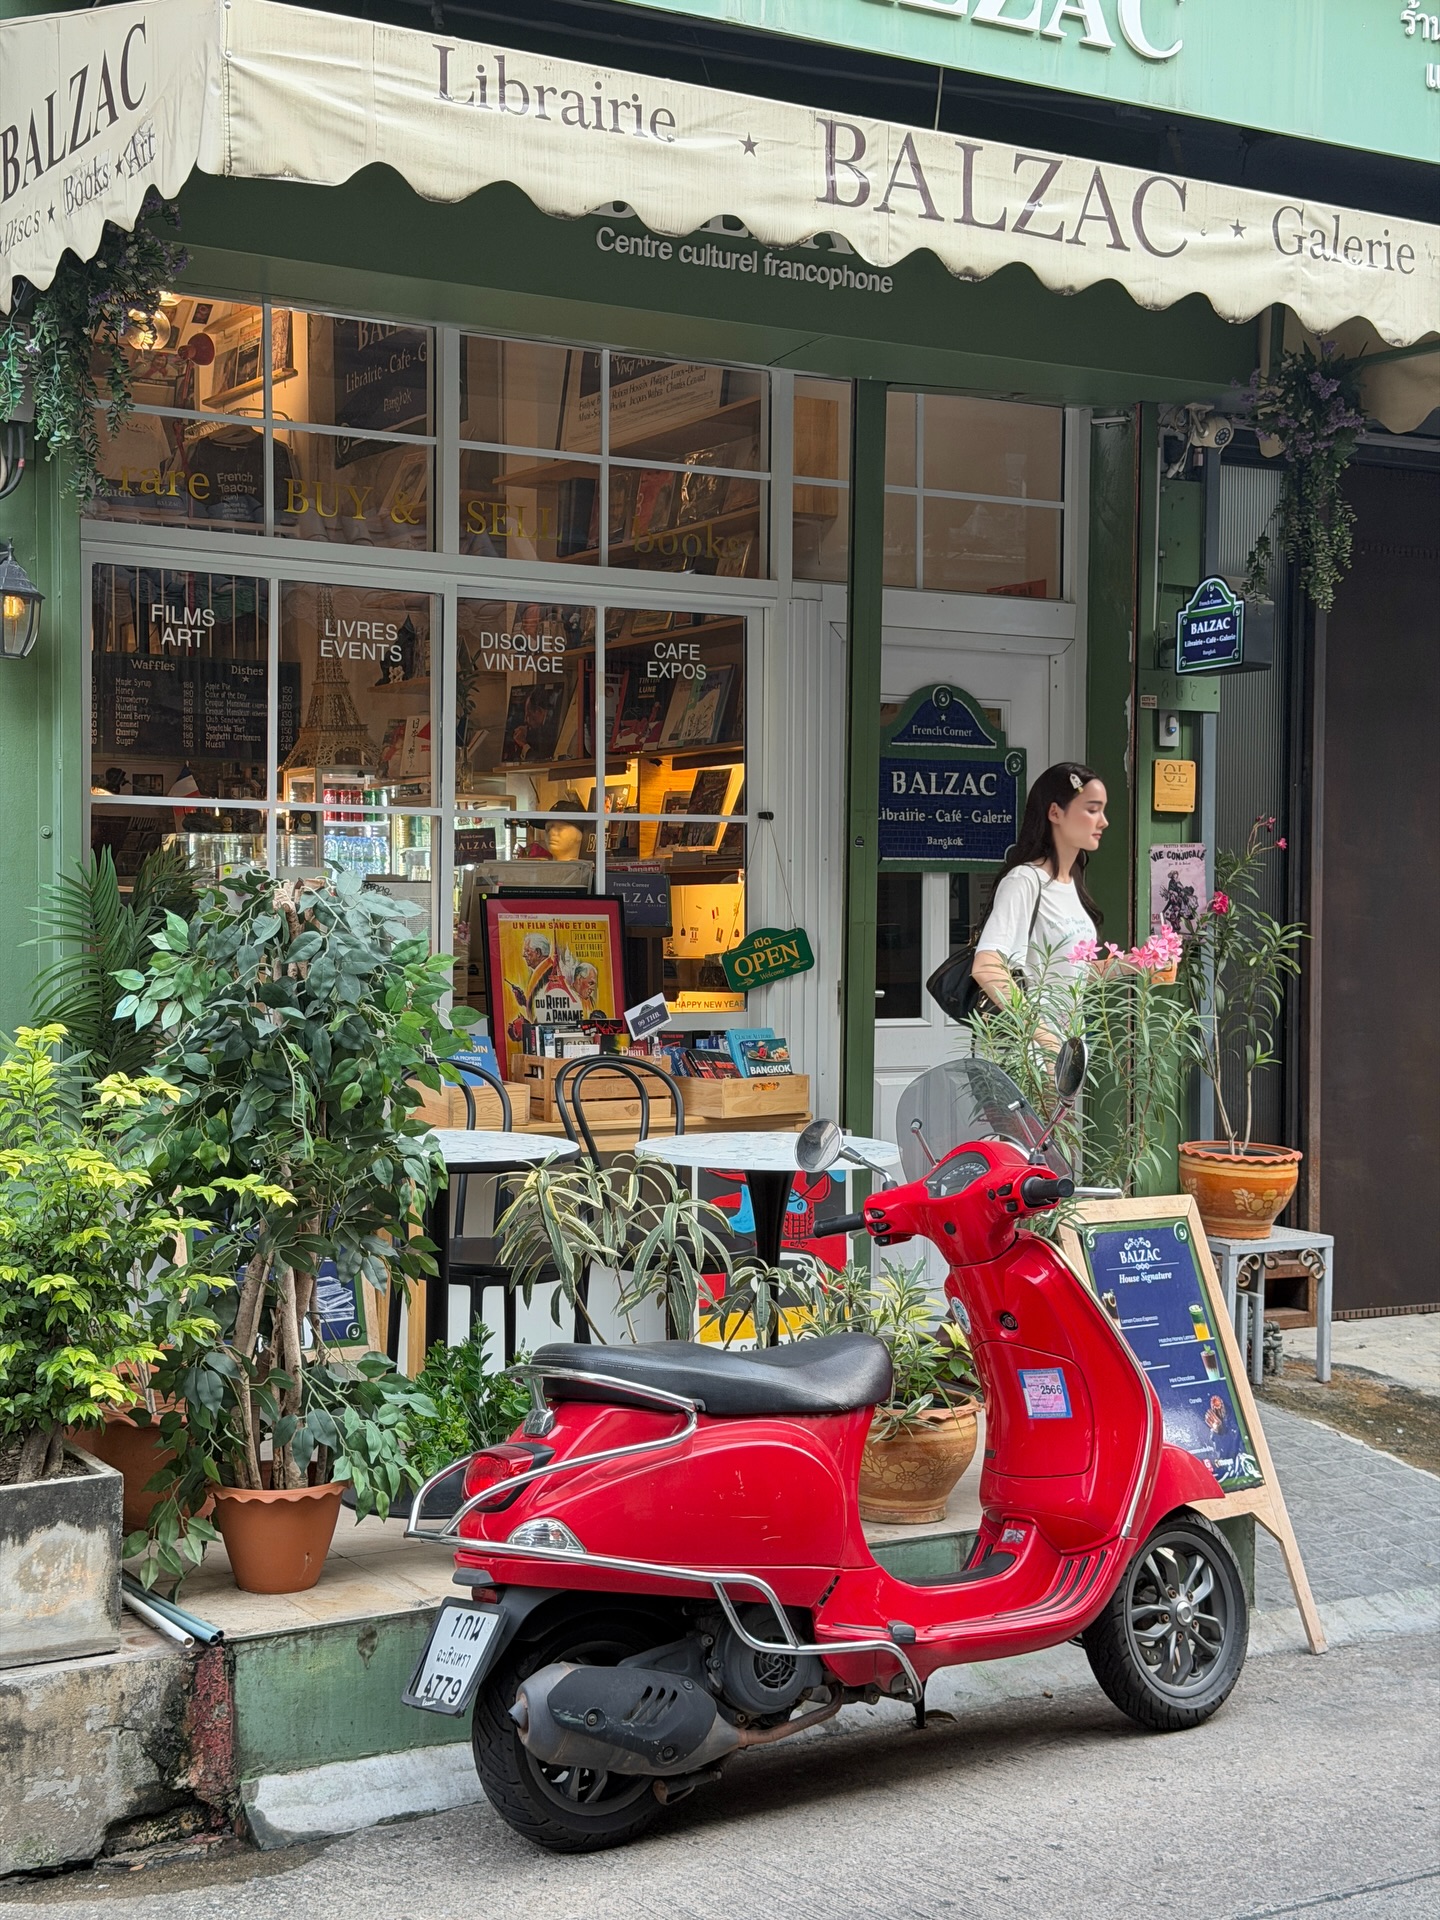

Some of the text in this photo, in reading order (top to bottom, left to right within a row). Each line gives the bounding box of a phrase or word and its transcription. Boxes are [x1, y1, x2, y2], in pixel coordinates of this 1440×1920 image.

[0, 15, 147, 204] BALZAC
[432, 43, 677, 144] Librairie
[815, 117, 1188, 259] BALZAC
[1271, 204, 1417, 275] Galerie
[63, 156, 110, 214] Books
[123, 127, 155, 179] Art
[595, 225, 673, 261] Centre
[678, 243, 758, 273] culturel
[763, 252, 894, 293] francophone
[346, 364, 383, 393] Librairie
[389, 348, 411, 374] Café
[216, 471, 253, 484] French
[217, 482, 258, 495] Teacher
[120, 464, 211, 501] rare
[283, 477, 374, 521] BUY
[390, 489, 421, 525] &
[466, 499, 561, 540] SELL
[150, 603, 216, 628] FILMS
[325, 618, 399, 642] LIVRES
[1190, 617, 1231, 635] BALZAC
[161, 627, 206, 648] ART
[480, 631, 566, 654] DISQUES
[320, 640, 403, 662] EVENTS
[653, 641, 701, 661] CAFE
[131, 659, 176, 671] Waffles
[231, 664, 264, 677] Dishes
[482, 652, 564, 674] VINTAGE
[646, 661, 707, 680] EXPOS
[912, 724, 972, 737] French Corner
[891, 770, 997, 796] BALZAC
[935, 808, 962, 822] Café
[971, 809, 1012, 823] Galerie
[454, 840, 496, 852] ALZAC
[926, 836, 964, 850] Bangkok
[1150, 849, 1207, 862] VIE CONJUGALE
[512, 922, 525, 930] UN
[527, 922, 546, 930] FILM
[548, 922, 570, 930] SANG
[753, 936, 772, 949] เปิด
[734, 940, 800, 977] OPEN
[759, 968, 786, 980] Welcome
[535, 995, 570, 1010] DU RIFIFI
[675, 1000, 745, 1009] HAPPY NEW YEAR
[546, 1009, 583, 1021] A PANAME
[750, 1063, 792, 1076] BANGKOK
[1119, 1247, 1162, 1264] BALZAC
[1119, 1271, 1173, 1284] House Signature
[1040, 1384, 1063, 1395] 2566
